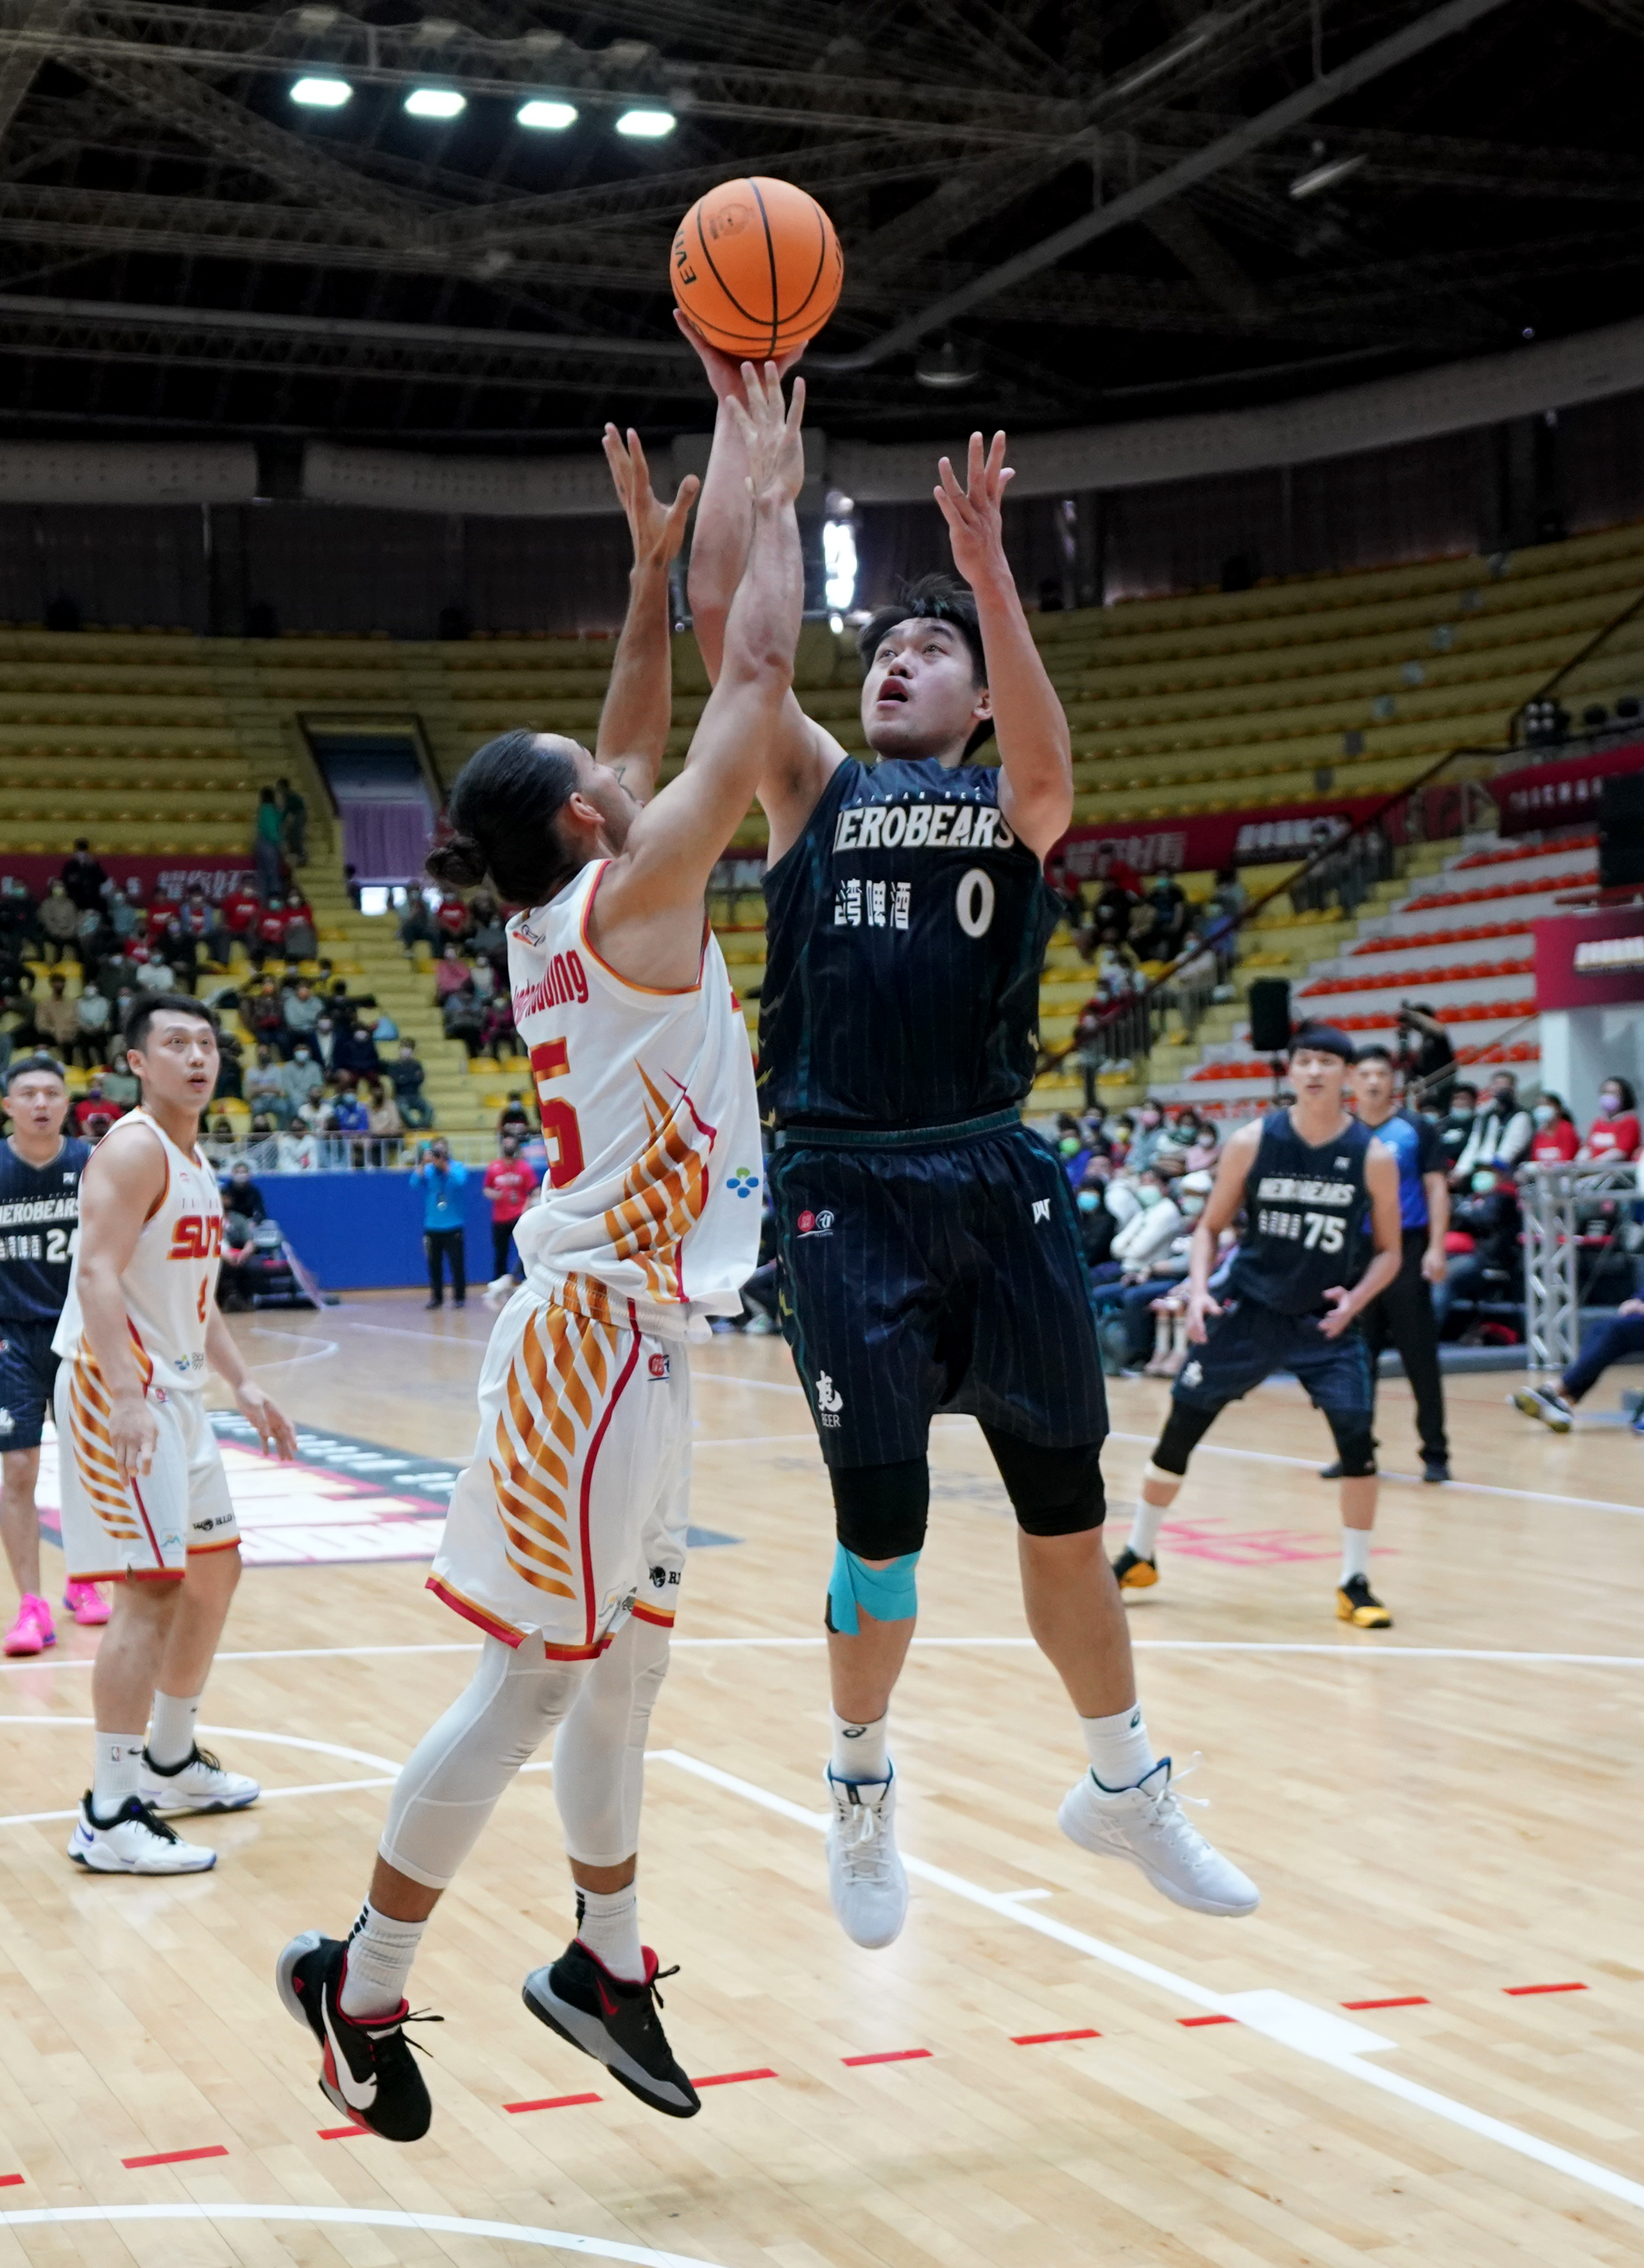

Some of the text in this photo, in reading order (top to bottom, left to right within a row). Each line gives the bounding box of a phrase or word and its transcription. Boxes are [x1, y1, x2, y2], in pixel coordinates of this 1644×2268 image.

[856, 791, 925, 804] AIWAN
[832, 805, 1015, 854] EROBEARS
[956, 867, 995, 938] 0
[0, 1197, 80, 1226] EROBEARS
[1303, 1212, 1346, 1253] 75
